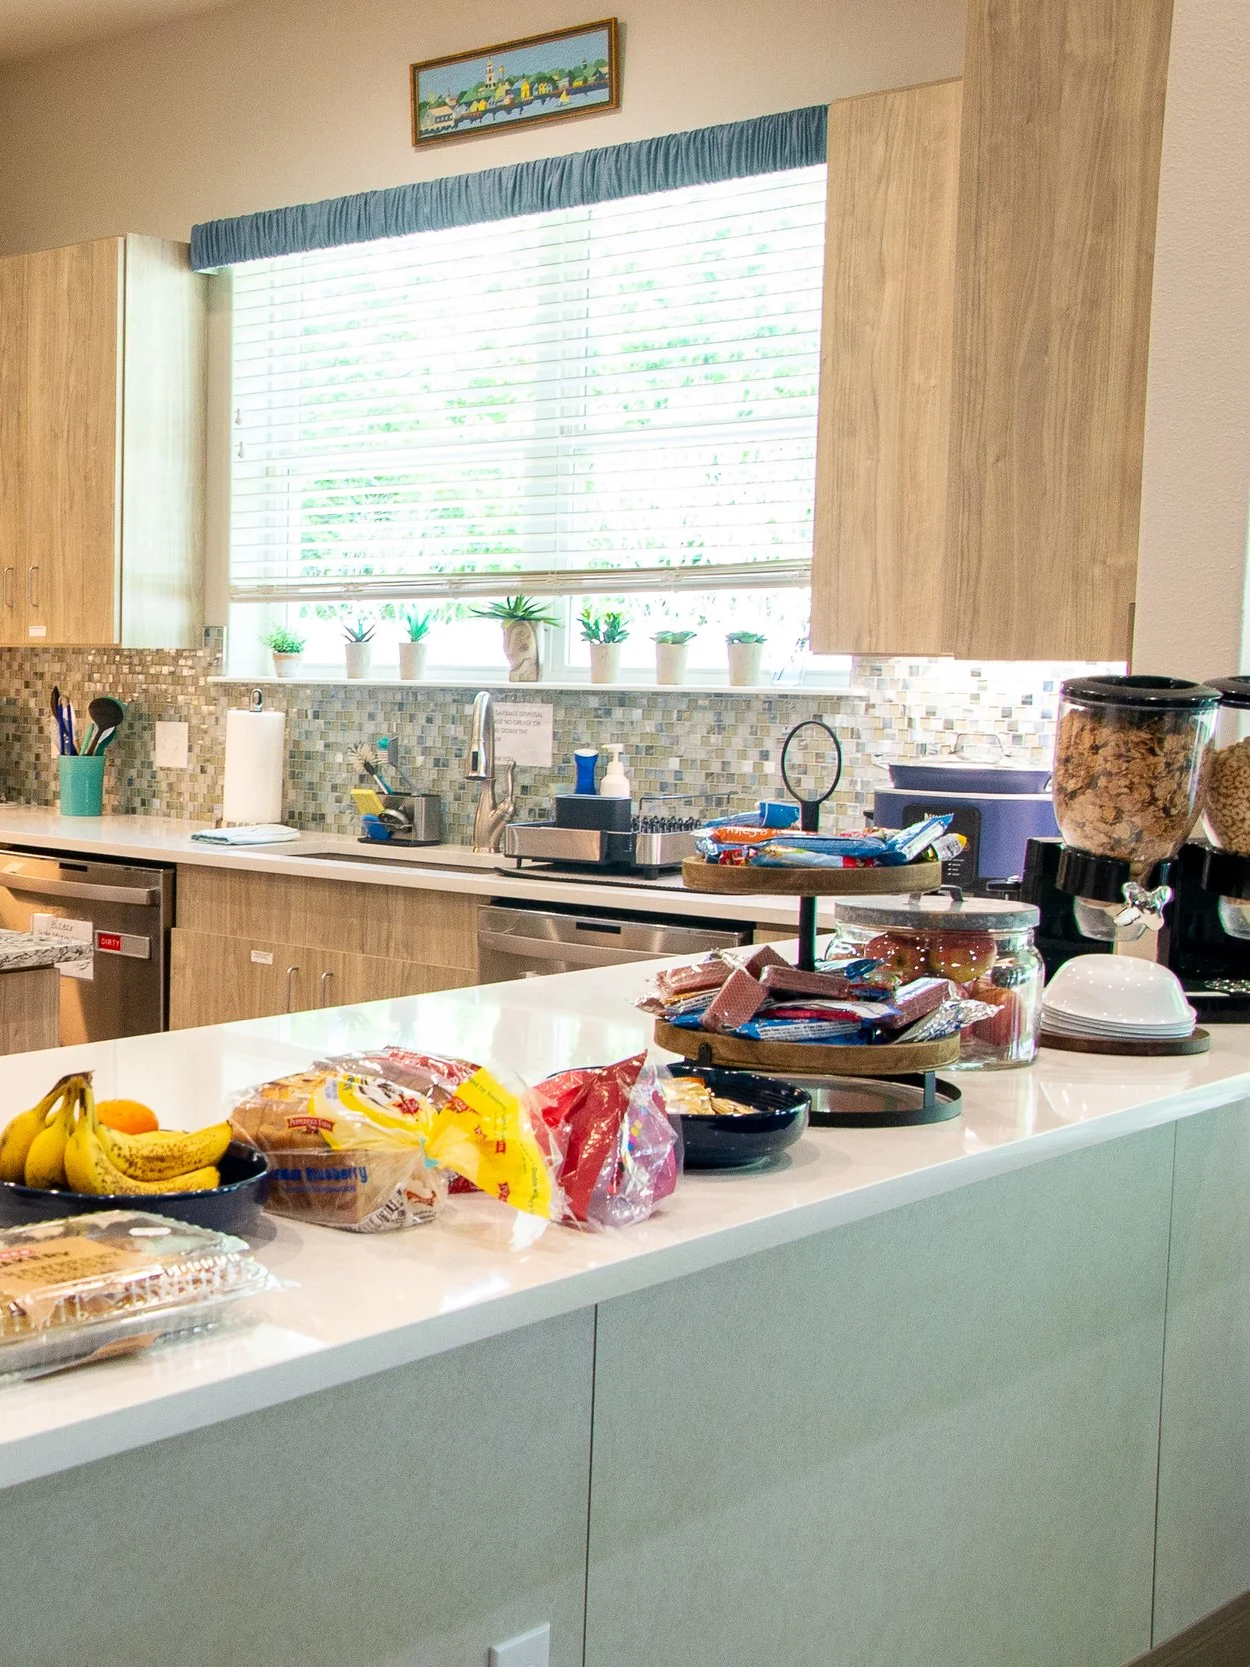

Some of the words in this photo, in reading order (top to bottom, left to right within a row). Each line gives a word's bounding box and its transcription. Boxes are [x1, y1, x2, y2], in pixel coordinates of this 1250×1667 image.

[512, 719, 532, 727] GREASE
[100, 937, 120, 947] DIRTY
[305, 1165, 368, 1184] Blueberry
